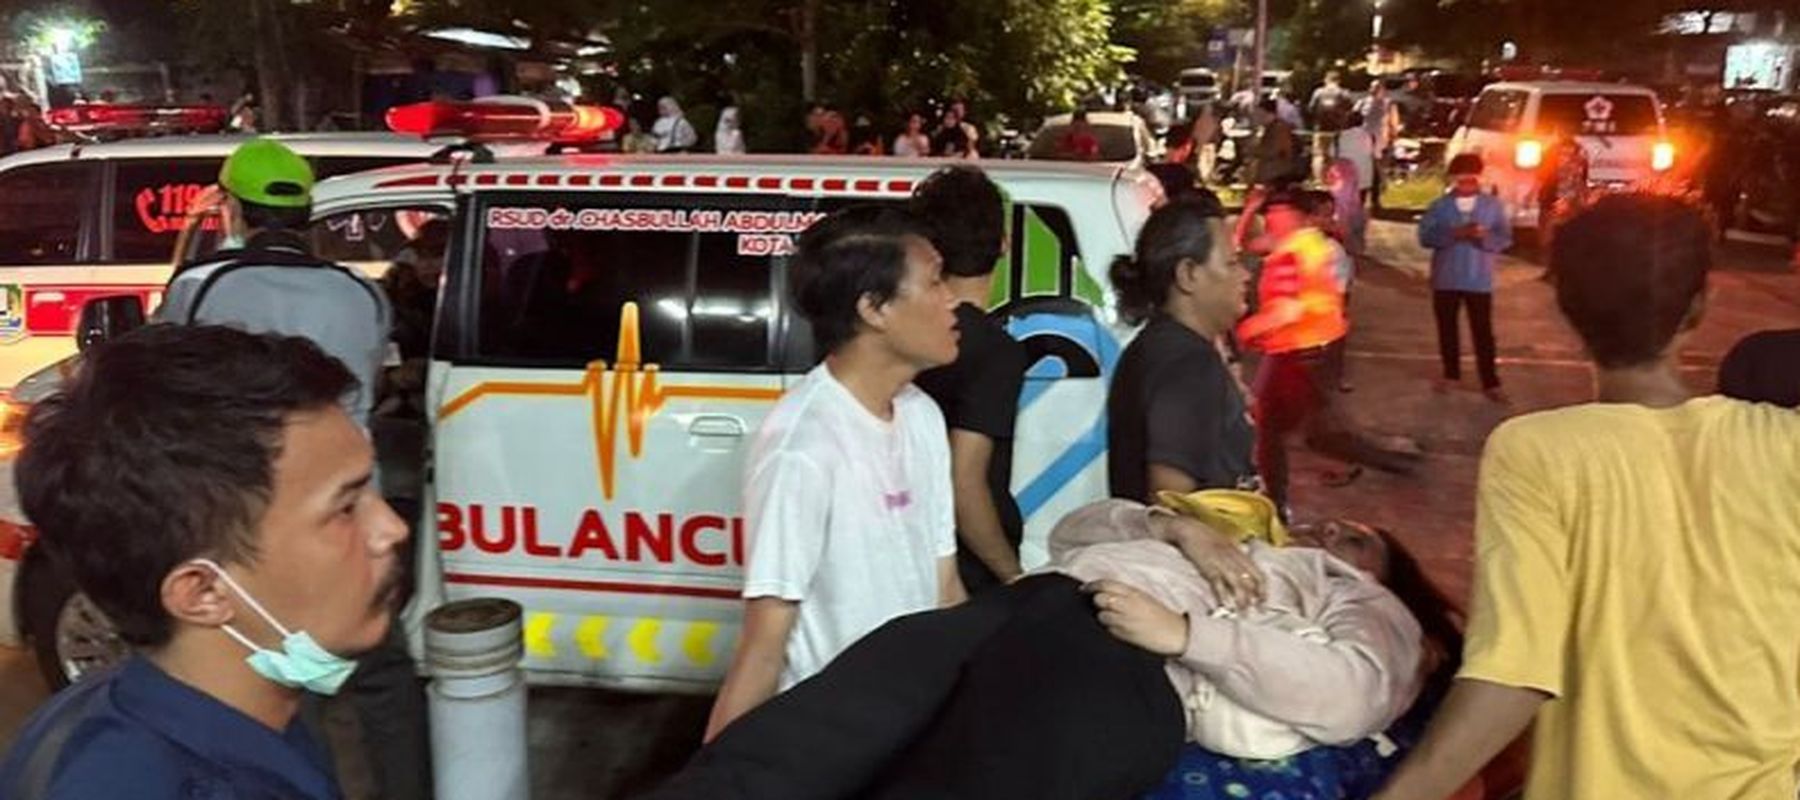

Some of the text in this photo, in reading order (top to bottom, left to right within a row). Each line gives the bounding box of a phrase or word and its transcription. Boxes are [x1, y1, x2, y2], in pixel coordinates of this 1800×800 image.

[488, 207, 547, 229] RSUD
[722, 211, 826, 232] ABDULM
[737, 234, 797, 255] KOTA
